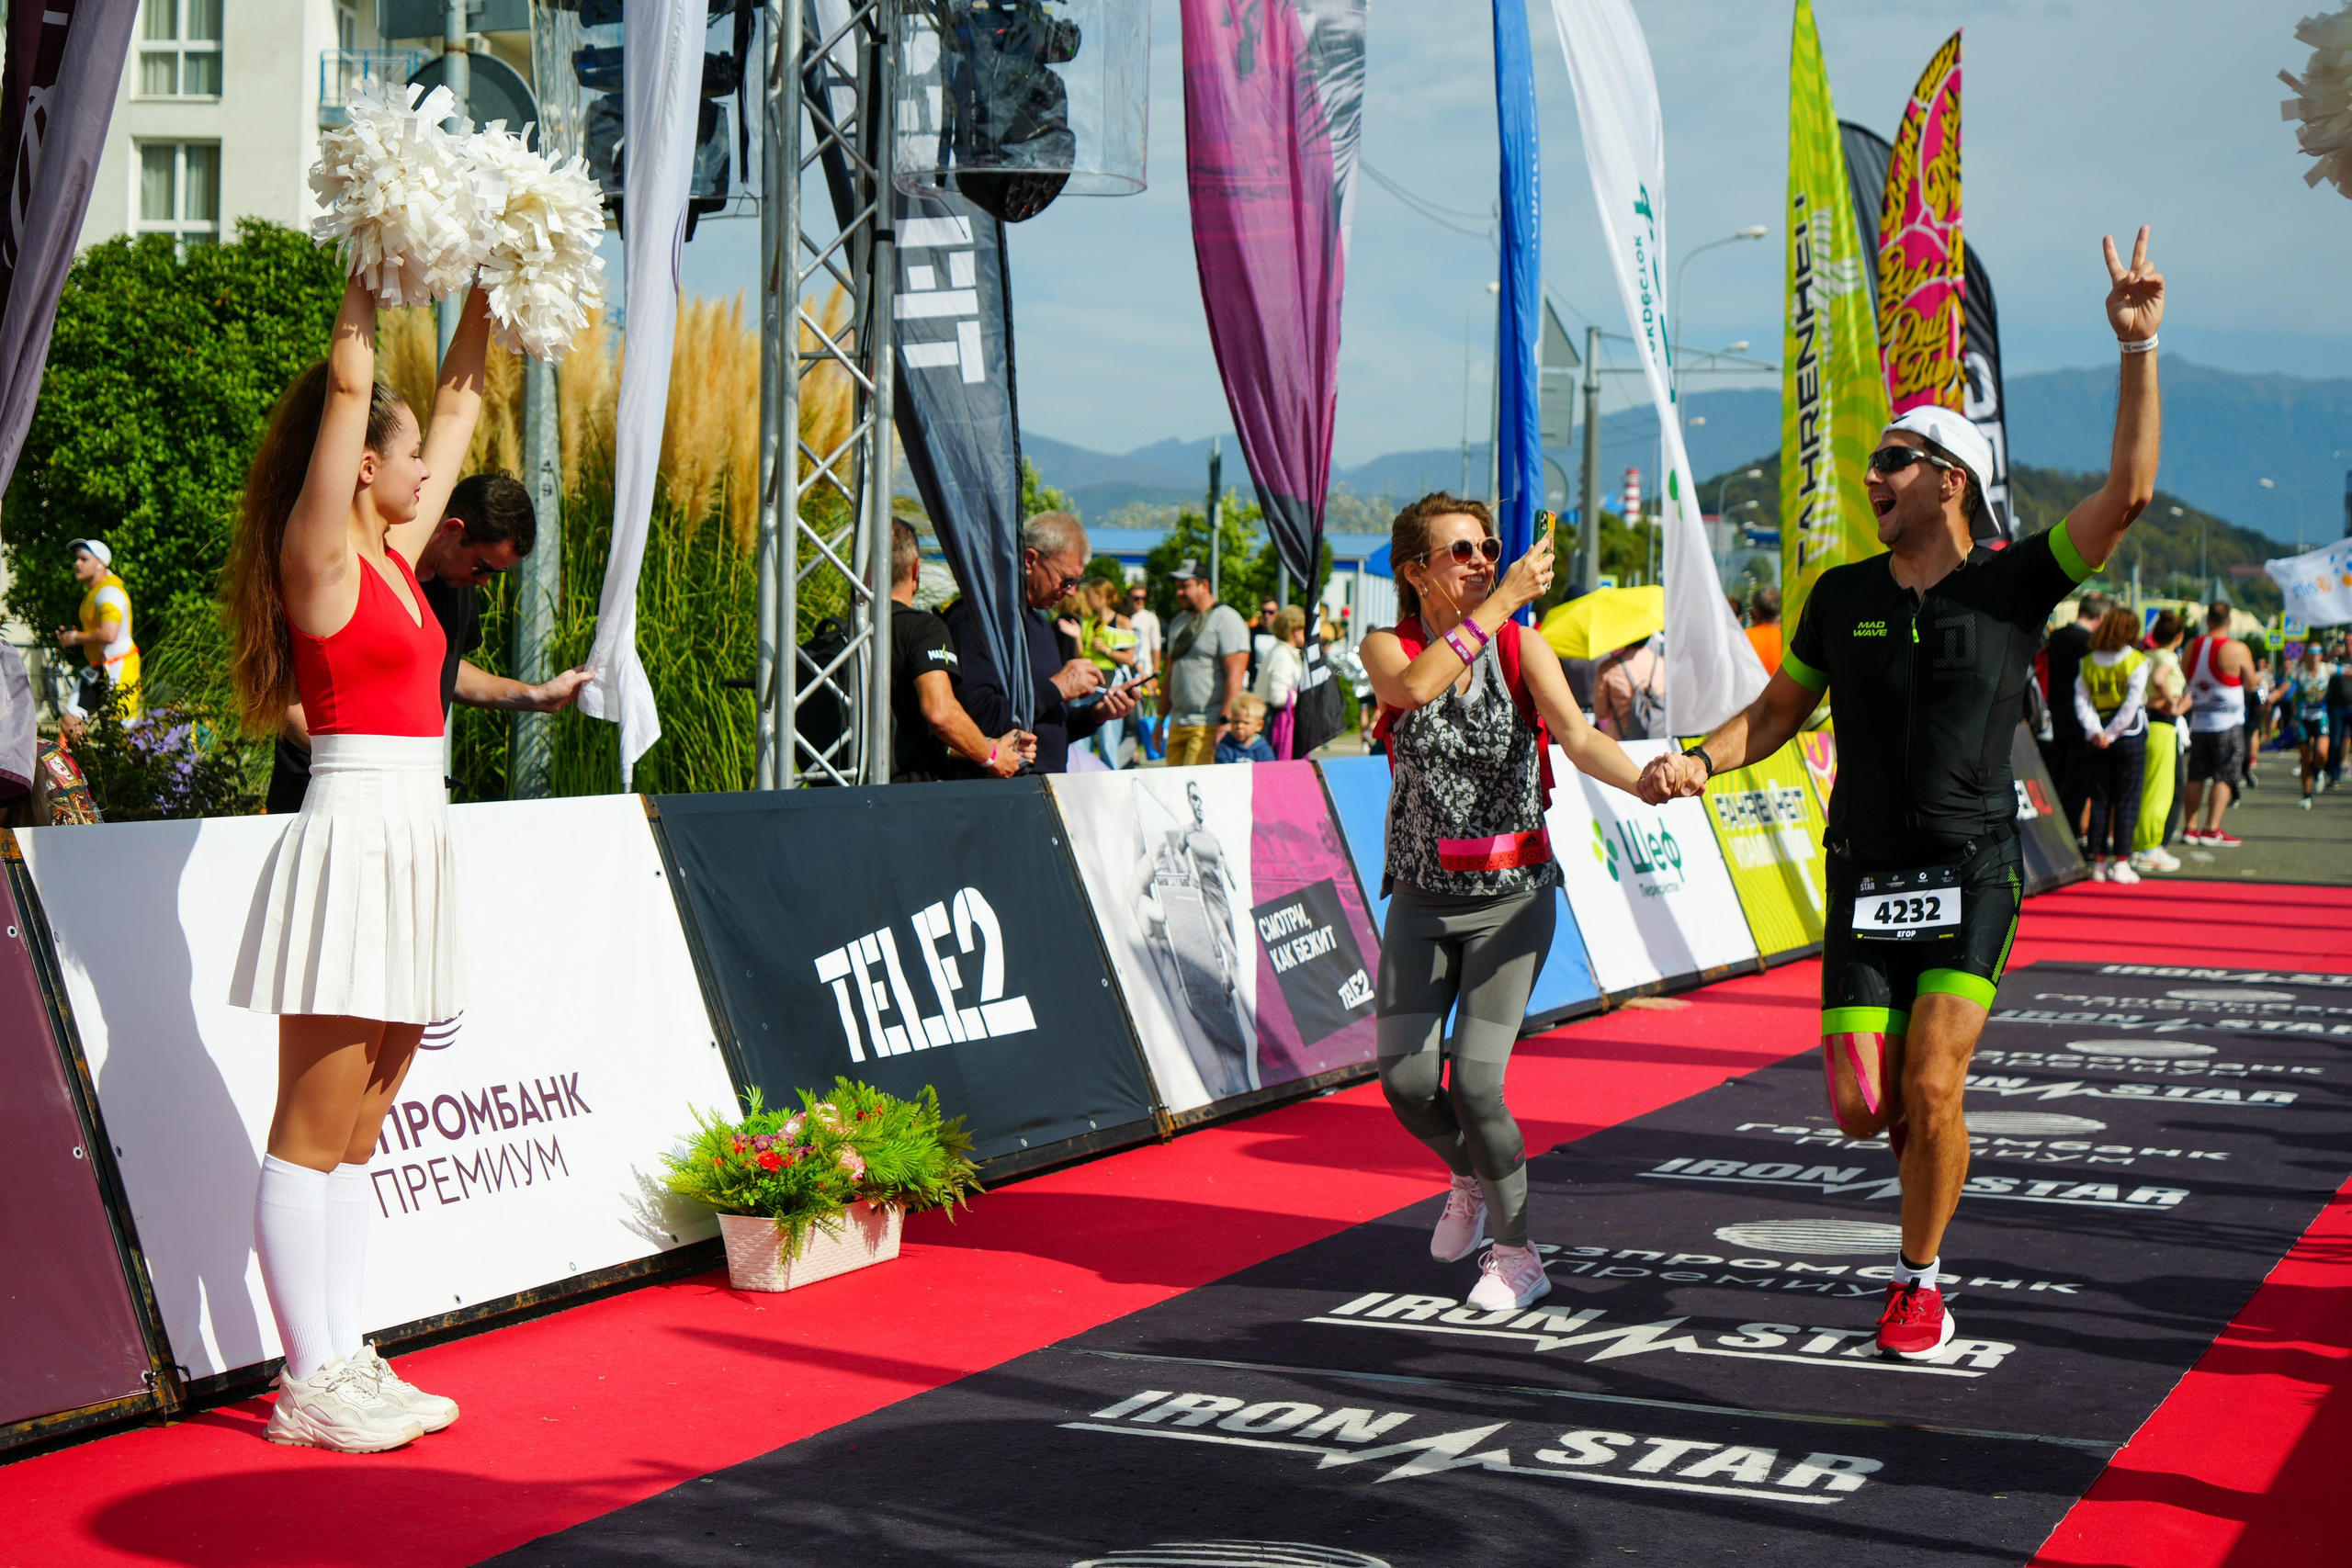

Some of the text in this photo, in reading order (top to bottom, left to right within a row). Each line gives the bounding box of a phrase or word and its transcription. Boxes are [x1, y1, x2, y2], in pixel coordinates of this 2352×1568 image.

[1616, 817, 1684, 883] Шеф
[1860, 883, 1875, 891] STAR
[1258, 903, 1312, 943] СМОТРИ,
[1874, 897, 1941, 924] 4232
[1269, 925, 1337, 974] КАК БЕЖИТ
[1896, 930, 1917, 938] ЕГОР
[814, 887, 1037, 1063] TELE2
[1338, 968, 1375, 1010] TELE2
[2099, 964, 2228, 979] IRON
[1999, 1010, 2145, 1023] IRON
[2110, 1083, 2299, 1105] STAR
[370, 1072, 593, 1158] ПРОМБАНК
[370, 1134, 569, 1218] ПРЕМИУМ
[1653, 1157, 2191, 1205] IRON STAR
[1329, 1292, 1609, 1333] IRON
[1090, 1390, 1884, 1493] IRON STAR
